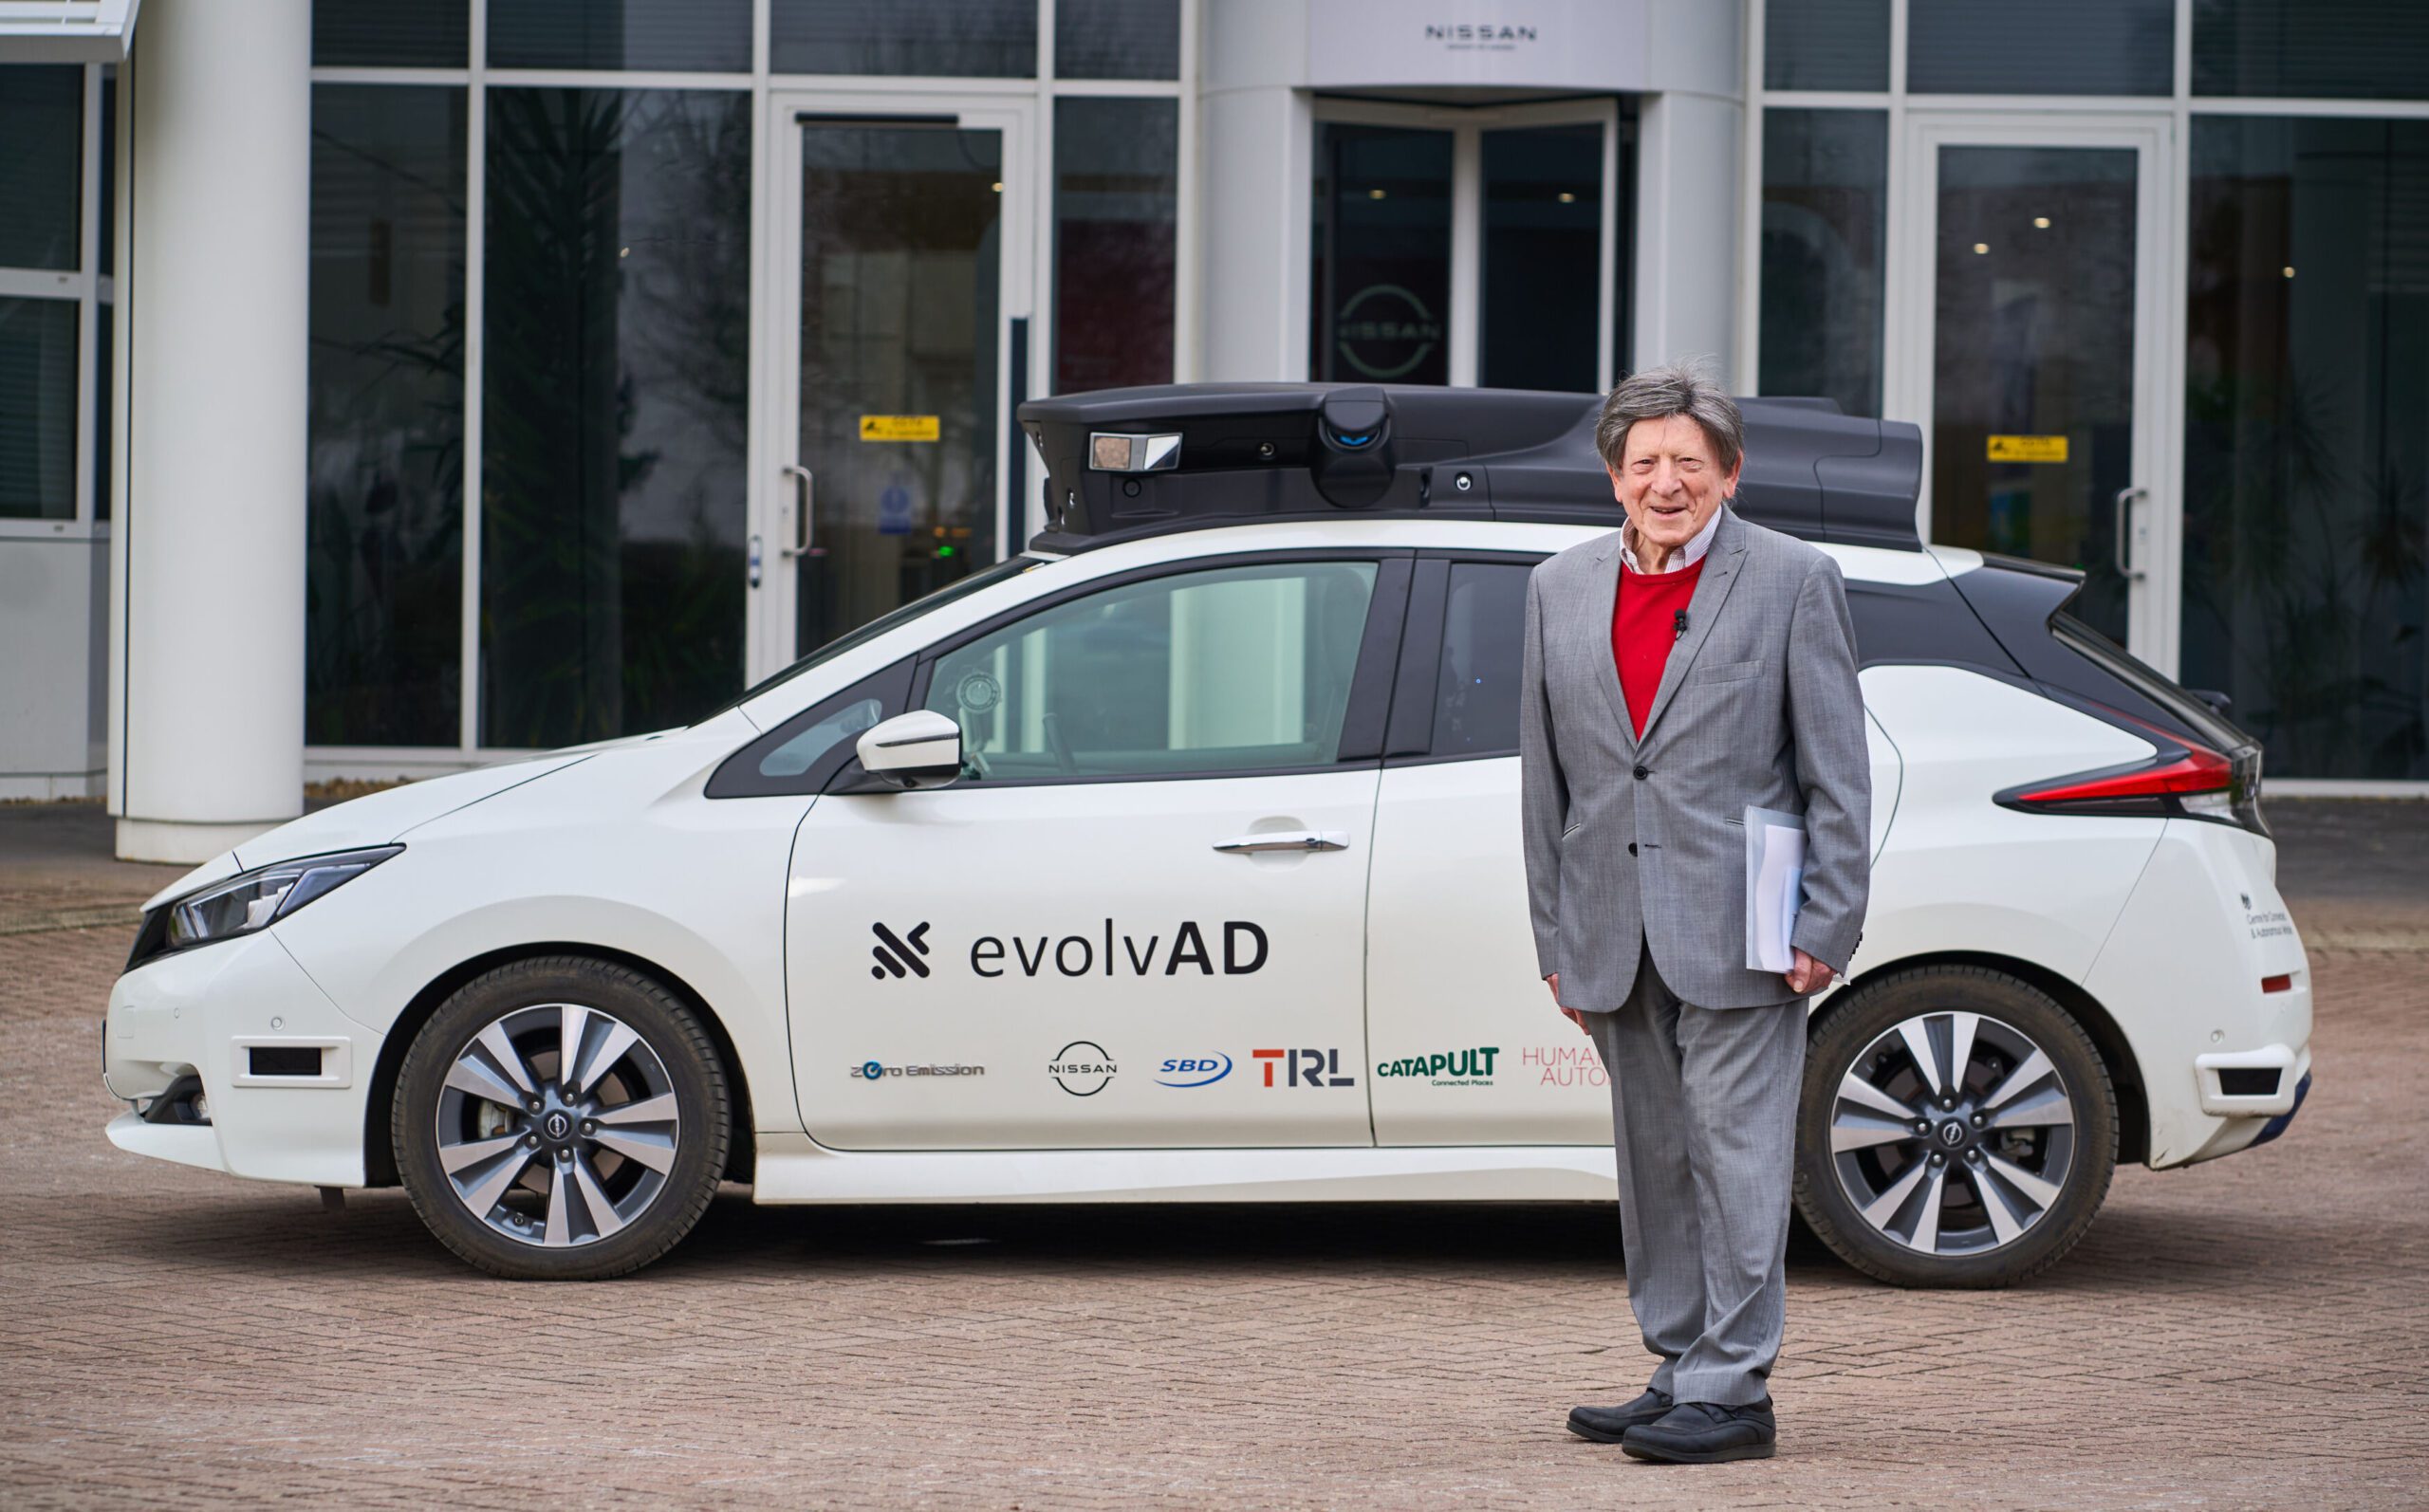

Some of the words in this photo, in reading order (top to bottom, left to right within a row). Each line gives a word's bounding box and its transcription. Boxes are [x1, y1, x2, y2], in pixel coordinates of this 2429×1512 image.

[1425, 25, 1537, 41] NISSAN
[970, 917, 1269, 978] evolvAD
[906, 1063, 985, 1077] Emission
[1048, 1063, 1117, 1075] NISSAN
[1159, 1058, 1218, 1073] SBD
[1252, 1048, 1355, 1088] TRL
[1377, 1046, 1500, 1078] CATAPULT
[1431, 1079, 1470, 1087] Connected
[1472, 1079, 1493, 1087] Places
[1540, 1066, 1611, 1086] AUTO
